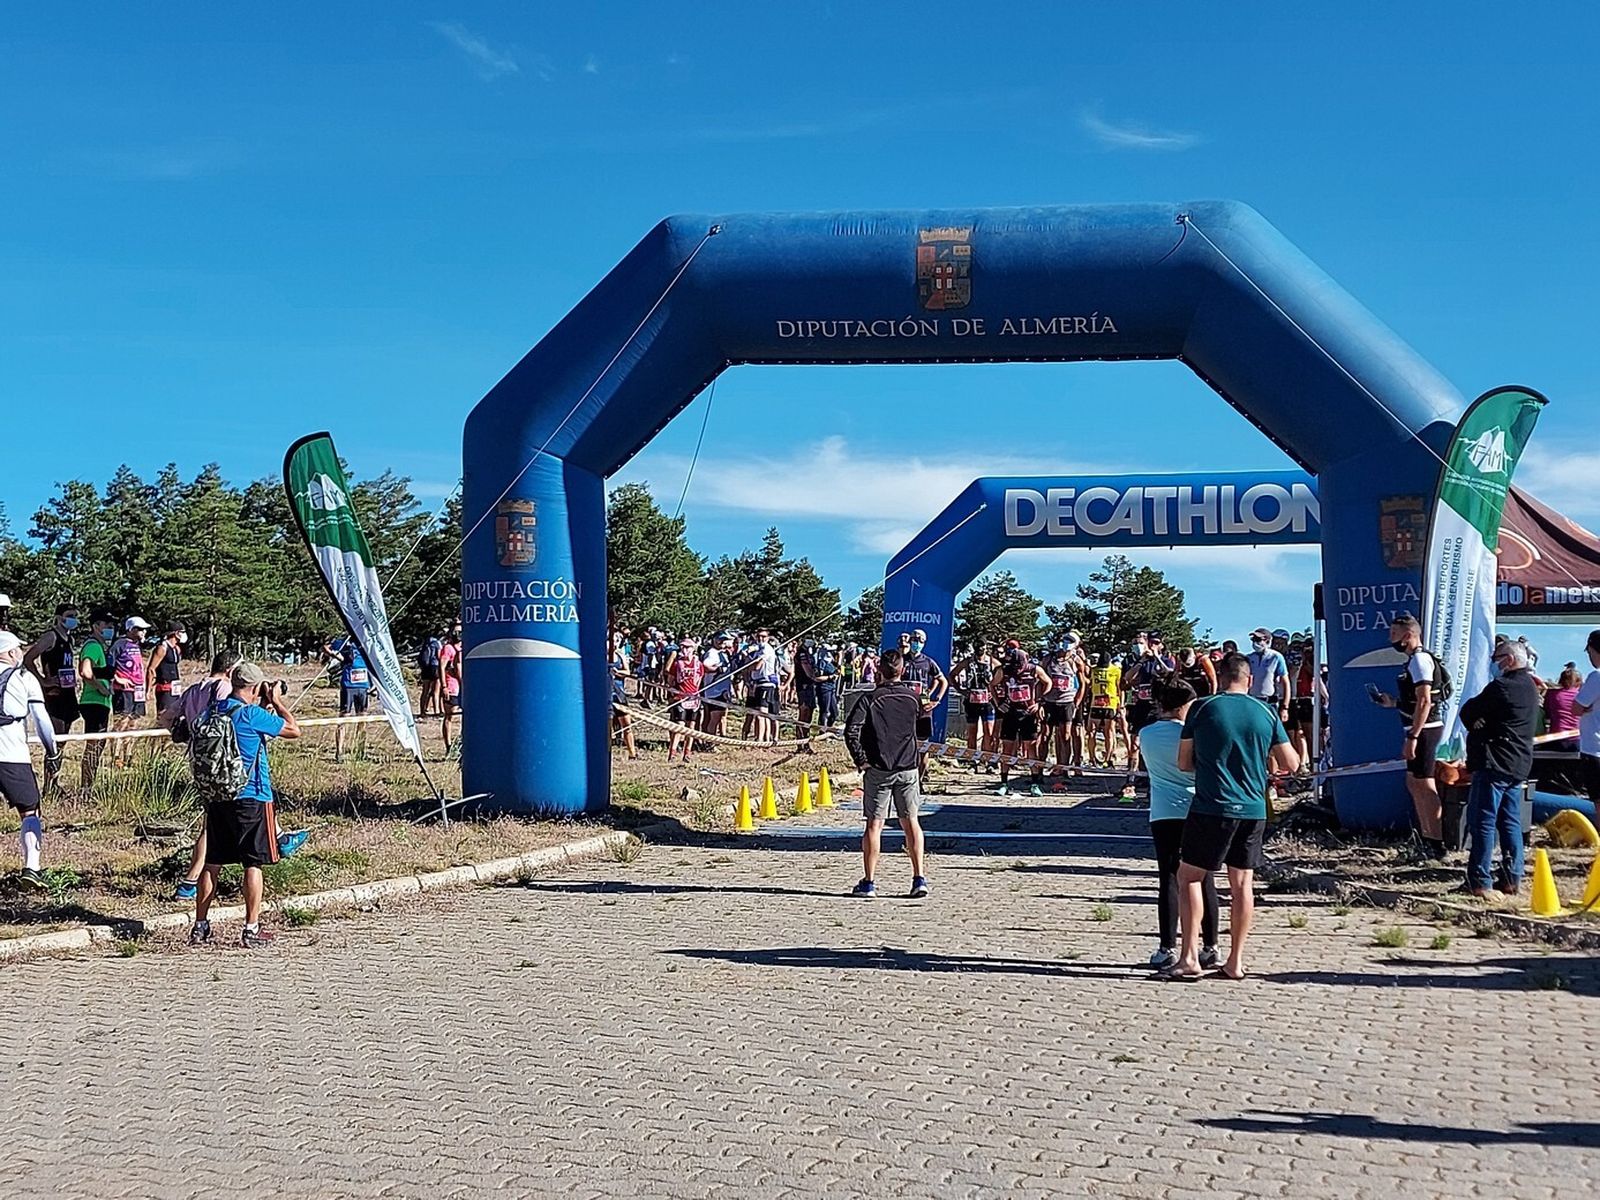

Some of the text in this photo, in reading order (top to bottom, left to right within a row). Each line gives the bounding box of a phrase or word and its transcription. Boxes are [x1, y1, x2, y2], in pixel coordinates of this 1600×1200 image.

[777, 311, 1118, 338] DIPUTACIÓN DE ALMERÍA
[1004, 483, 1321, 537] DECATHLON
[1439, 538, 1452, 590] DEPORTES
[1449, 536, 1464, 600] SENDERISMO
[464, 577, 582, 600] DIPUTACIÓN
[1338, 583, 1420, 606] DIPUTA
[465, 600, 580, 624] DE ALMERÍA
[885, 611, 941, 625] DECATHLON
[1341, 612, 1367, 631] DE
[1454, 569, 1475, 706] DELEGACIÓN ALMERIENSE
